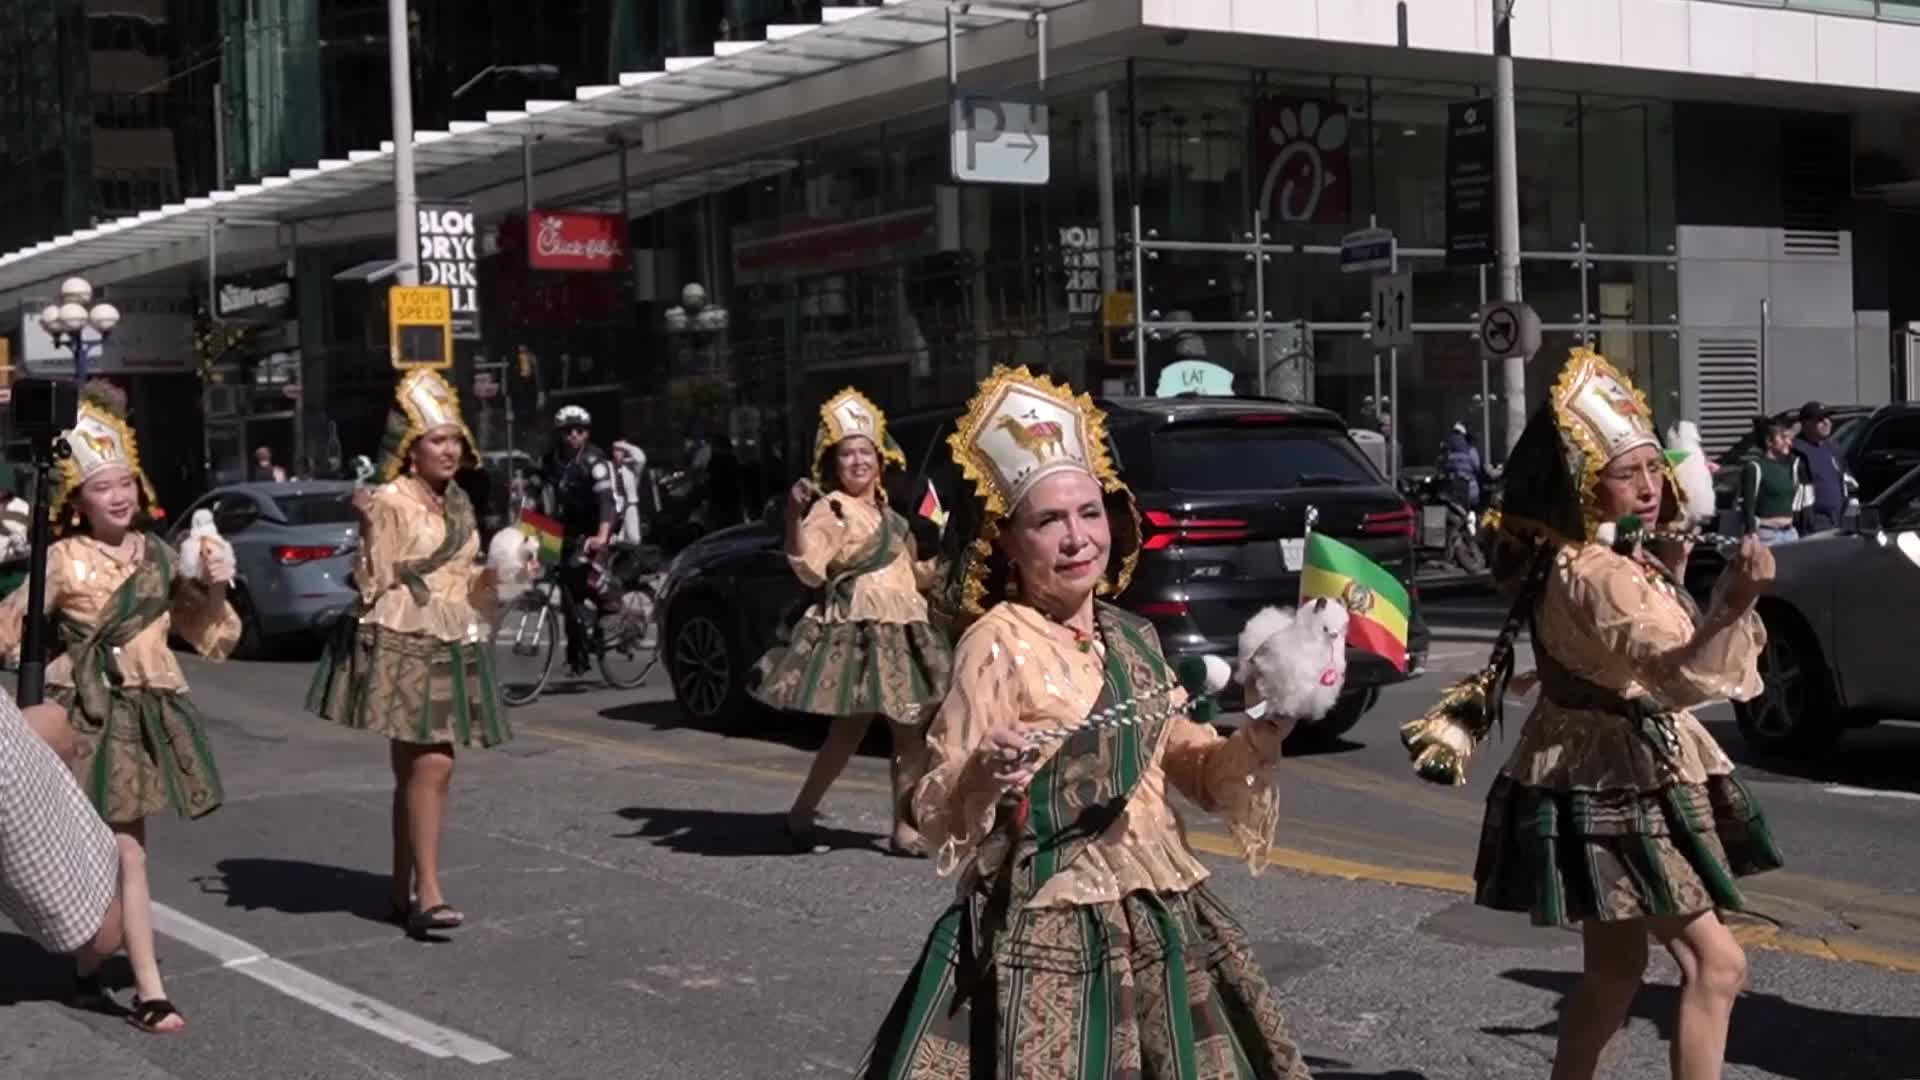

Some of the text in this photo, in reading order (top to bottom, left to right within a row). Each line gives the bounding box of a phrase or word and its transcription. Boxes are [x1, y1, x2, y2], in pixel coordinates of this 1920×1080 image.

[963, 96, 1006, 171] P
[399, 290, 441, 304] YOUR
[396, 305, 445, 320] SPEED
